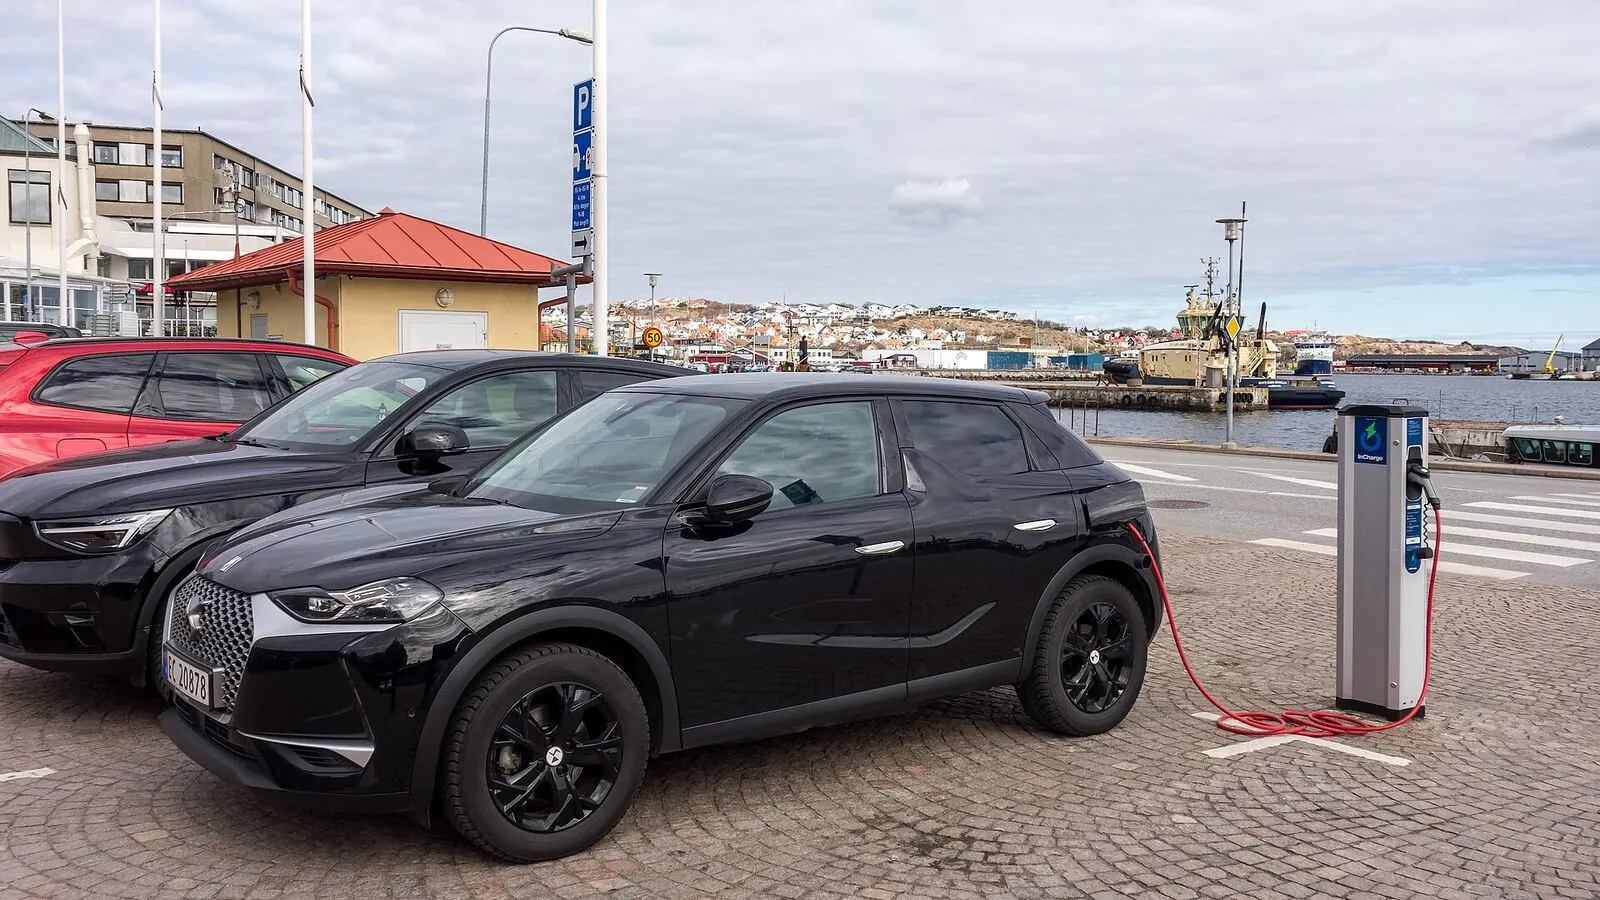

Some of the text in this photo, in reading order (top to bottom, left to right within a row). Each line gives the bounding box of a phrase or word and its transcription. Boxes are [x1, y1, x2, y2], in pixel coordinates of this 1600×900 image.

[578, 86, 590, 126] P
[648, 332, 660, 343] 50
[1357, 453, 1384, 462] InCharge
[168, 655, 207, 700] EC 20878
